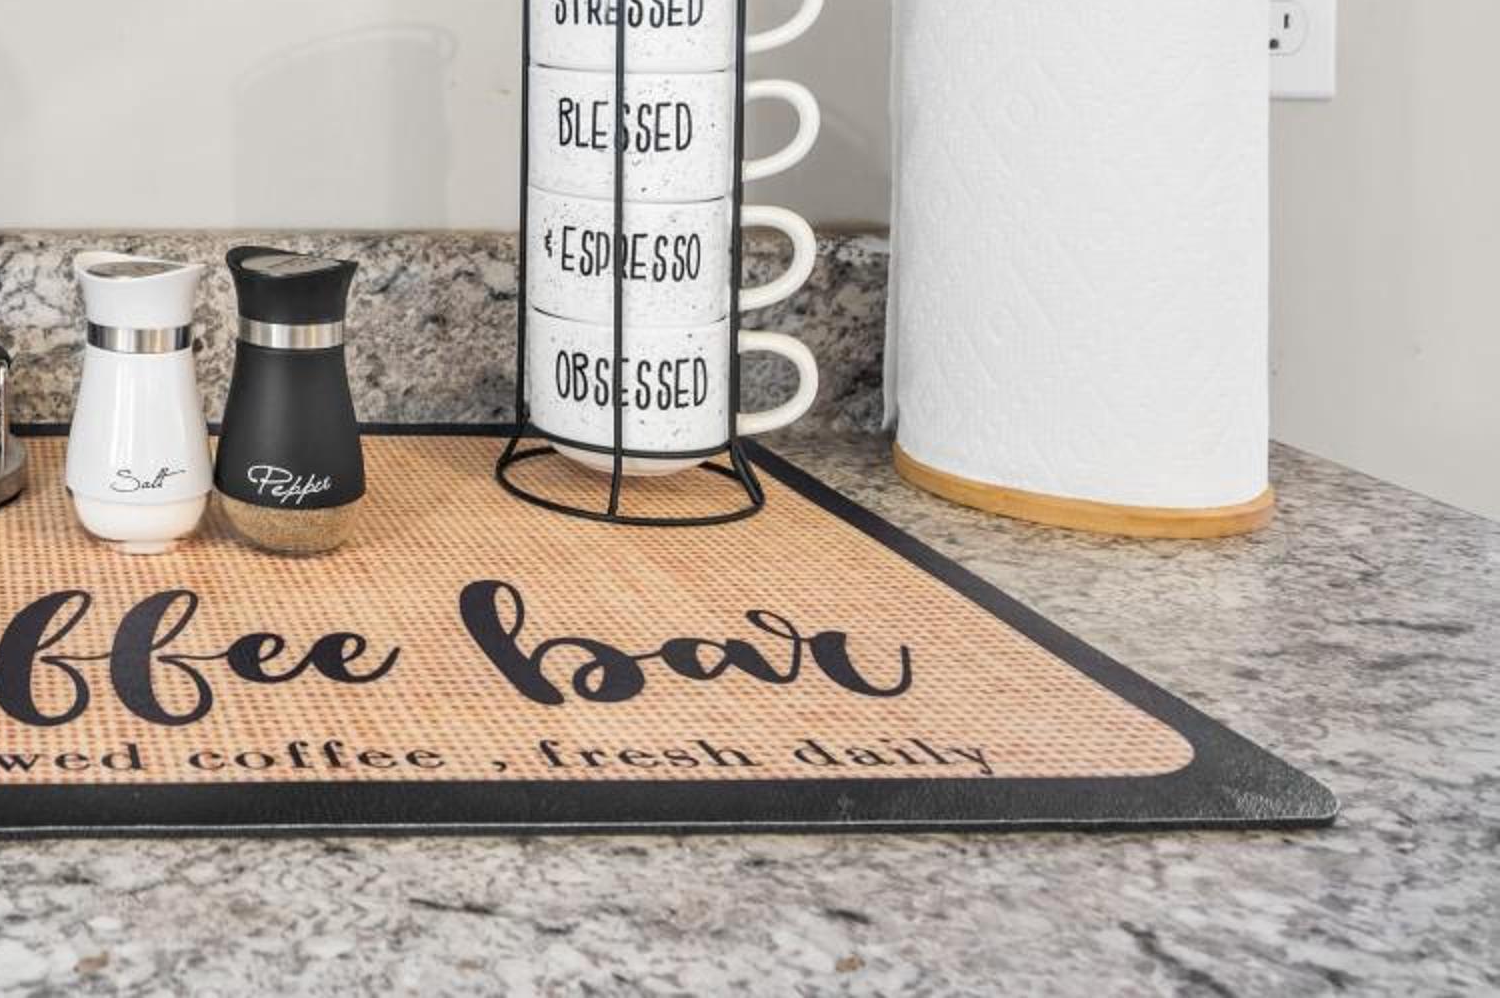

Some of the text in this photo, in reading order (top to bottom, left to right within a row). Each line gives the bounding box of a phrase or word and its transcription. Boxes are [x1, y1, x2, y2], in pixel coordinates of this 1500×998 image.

[110, 467, 187, 493] Salt
[247, 465, 331, 505] Pepper
[458, 579, 913, 705] bar
[537, 738, 761, 769] fresh
[792, 736, 996, 777] daily
